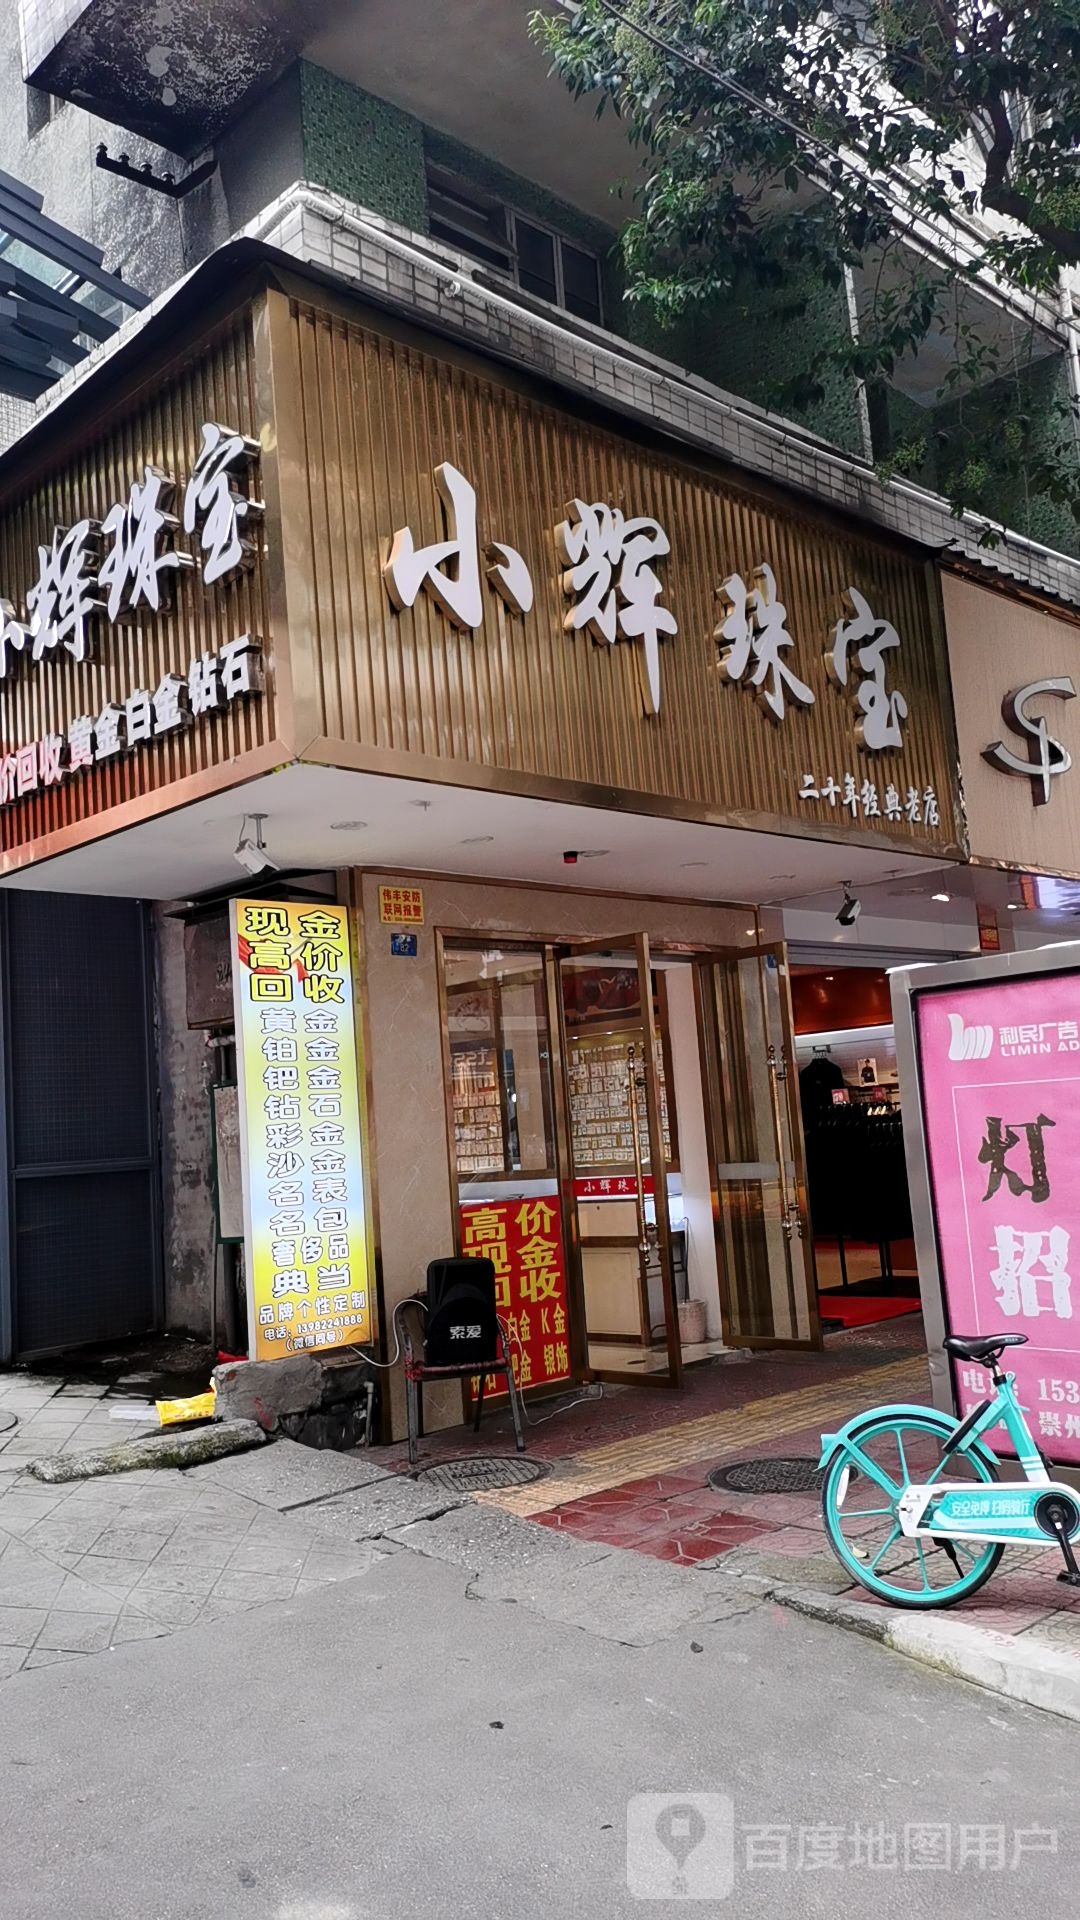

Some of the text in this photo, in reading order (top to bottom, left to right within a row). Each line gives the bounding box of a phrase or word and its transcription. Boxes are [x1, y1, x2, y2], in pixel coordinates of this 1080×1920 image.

[384, 462, 908, 750] 小辉珠宝
[799, 772, 939, 825] 二十年经典老店
[246, 907, 341, 939] 现金
[249, 940, 343, 972] 高价
[250, 973, 345, 1003] 回收
[261, 1008, 338, 1034] 黄金
[999, 1021, 1079, 1045] 利民广告
[262, 1037, 340, 1062] 铂金
[1001, 1042, 1051, 1056] LIMIN
[263, 1064, 341, 1091] 钯金
[264, 1093, 342, 1120] 钻石
[266, 1121, 345, 1149] 彩金
[267, 1149, 346, 1178] 沙金
[268, 1177, 348, 1207] 名表
[584, 1178, 646, 1193] 小辉珠
[270, 1207, 348, 1236] 名包
[463, 1201, 557, 1243] 高价
[272, 1233, 350, 1267] 奢侈品
[273, 1263, 350, 1298] 典当
[990, 1225, 1072, 1318] 招
[259, 1291, 365, 1325] 品牌个性定制
[297, 1314, 362, 1334] 13982241888
[450, 1325, 482, 1339] 索爱
